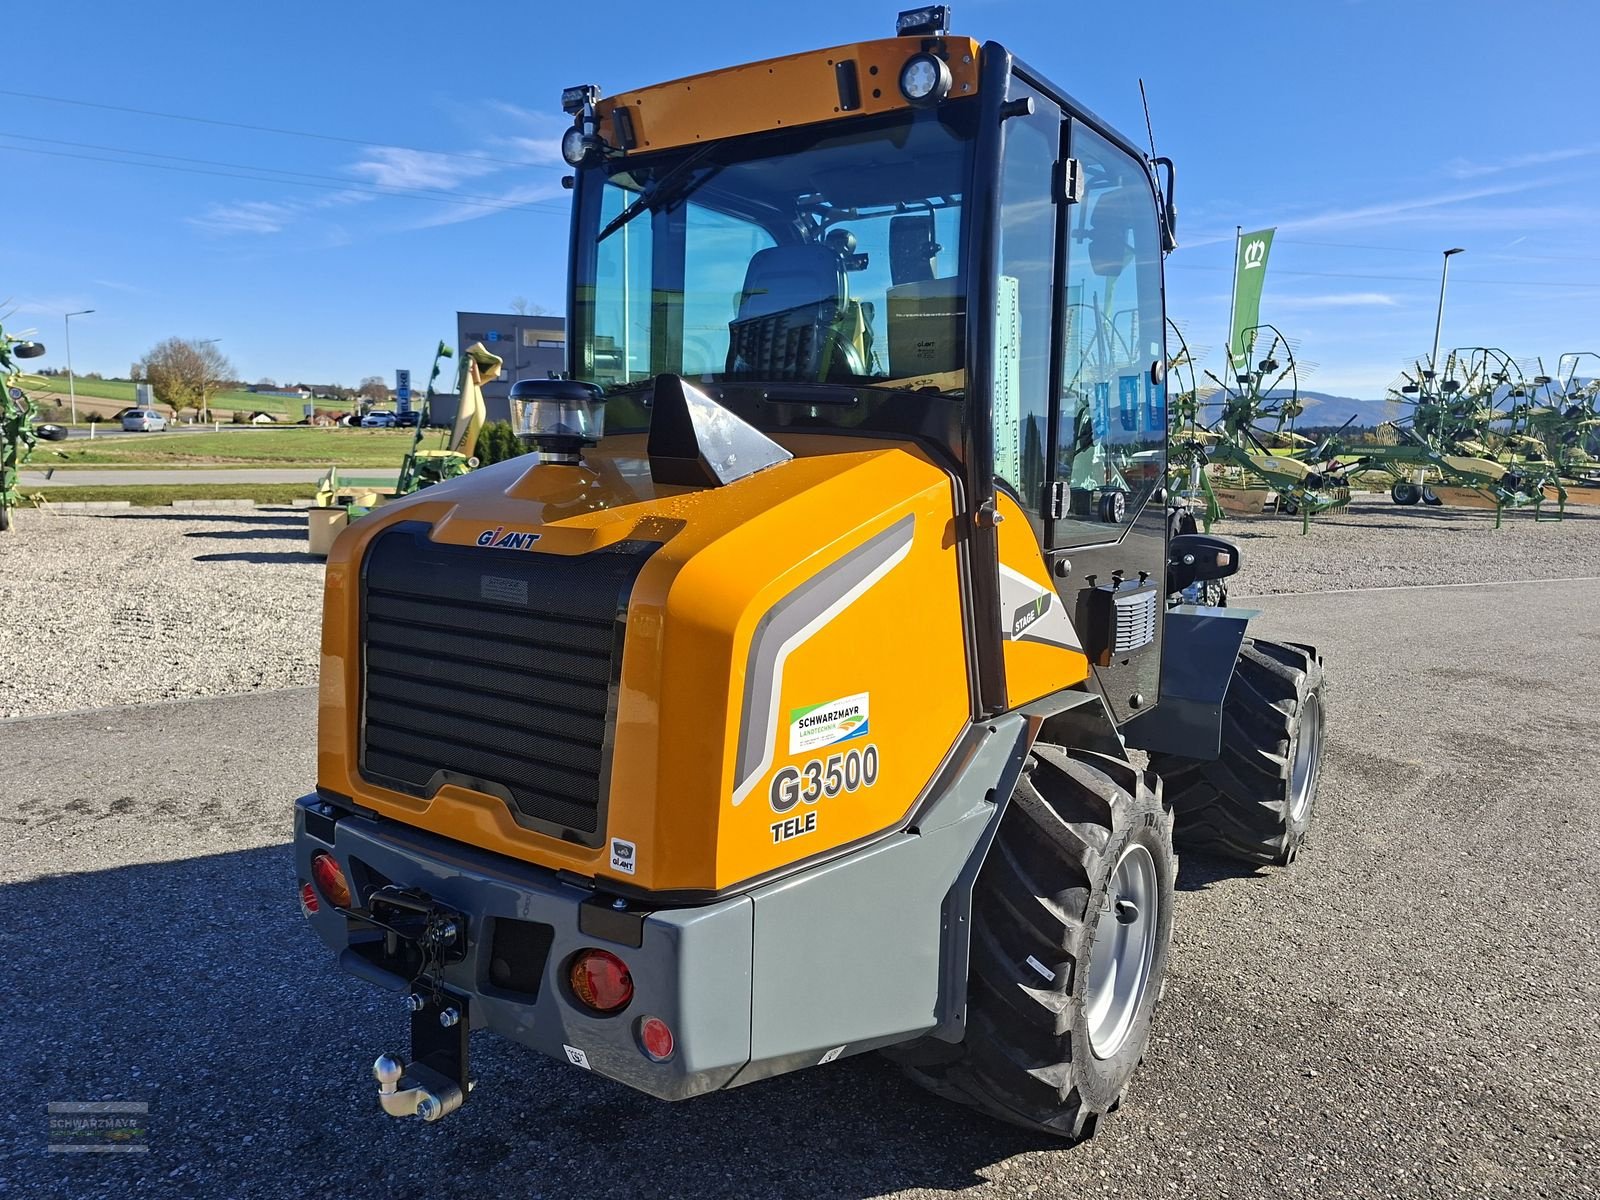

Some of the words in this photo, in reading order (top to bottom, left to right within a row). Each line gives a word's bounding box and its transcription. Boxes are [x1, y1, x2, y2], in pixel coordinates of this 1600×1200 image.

[1015, 609, 1035, 632] STAGE
[798, 706, 859, 729] SCHWARZMAYR
[800, 723, 836, 738] LANDTECHNIK
[769, 744, 878, 813] G3500
[771, 811, 816, 843] TELE
